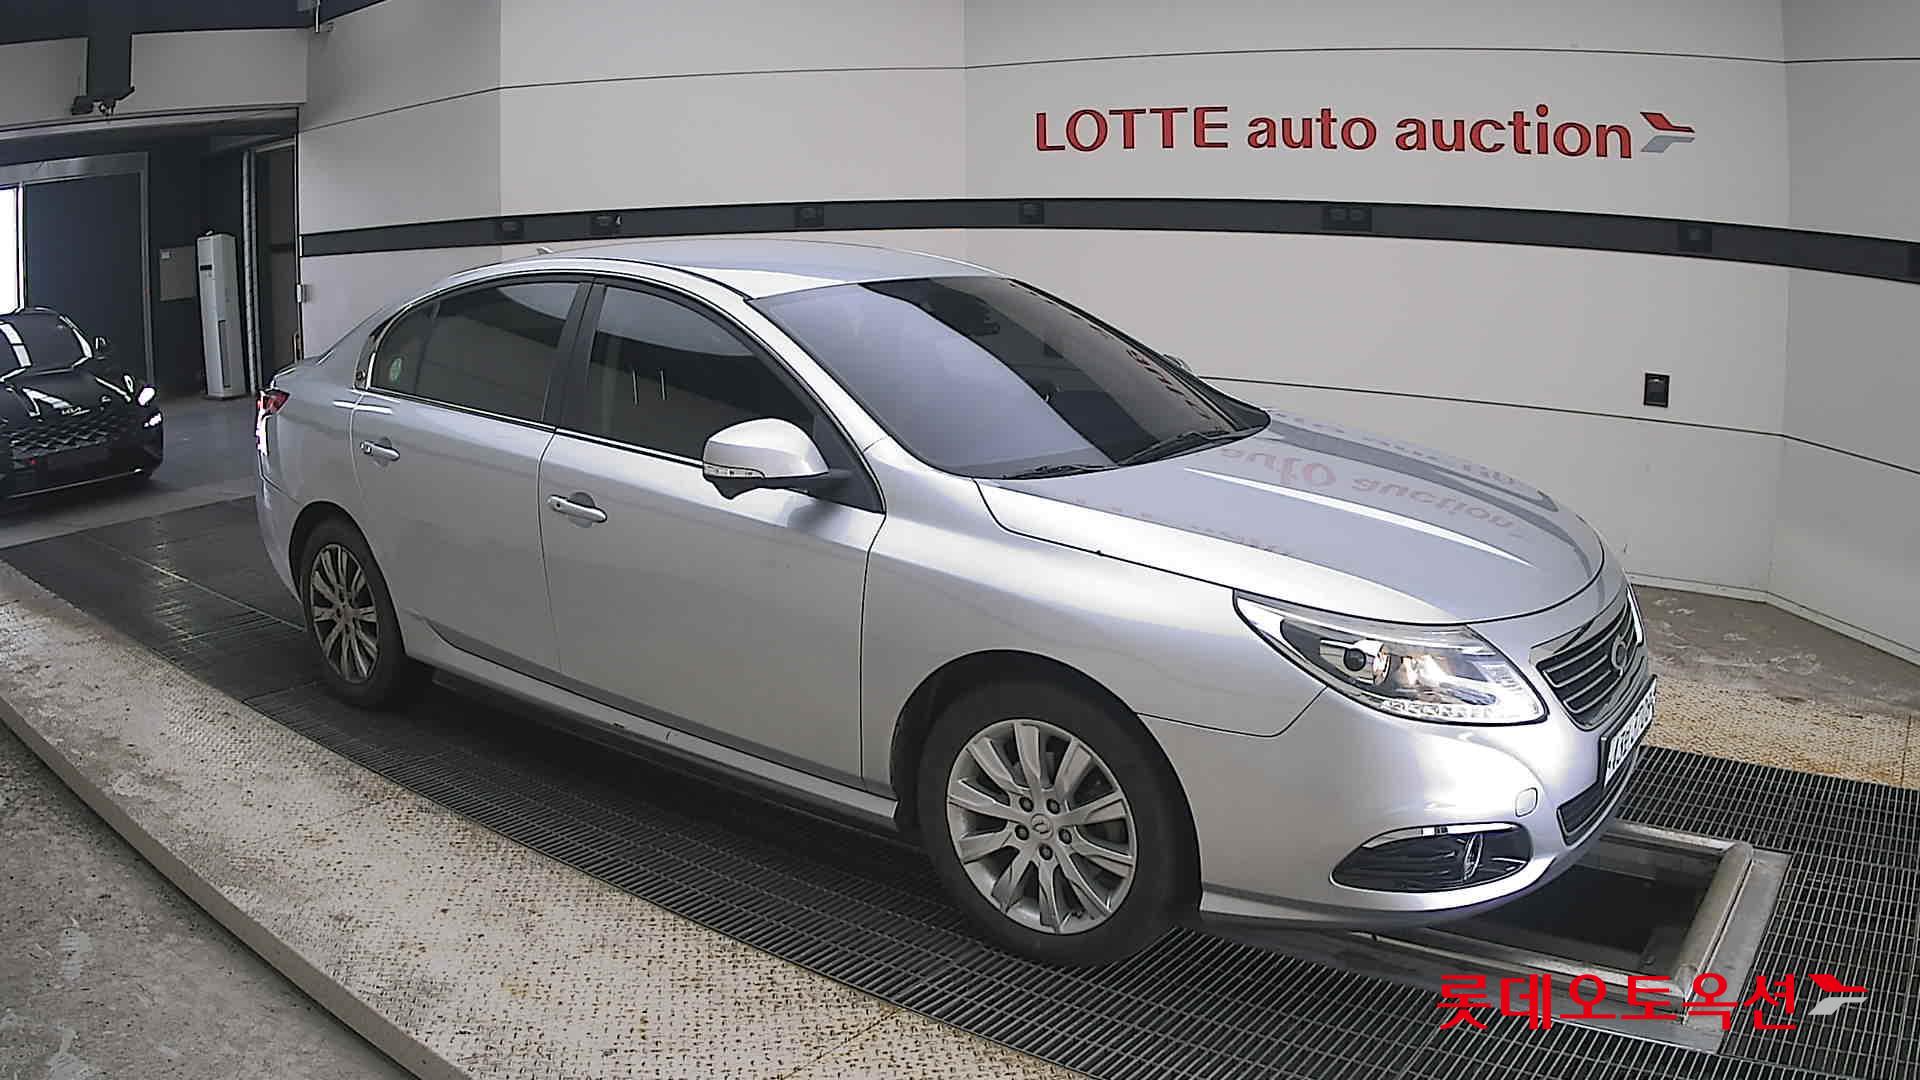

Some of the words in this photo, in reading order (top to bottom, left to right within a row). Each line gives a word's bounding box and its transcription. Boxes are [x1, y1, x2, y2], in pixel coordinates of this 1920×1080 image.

[1035, 106, 1228, 152] LOTTE
[1247, 109, 1377, 150] auto
[1395, 104, 1633, 158] auction
